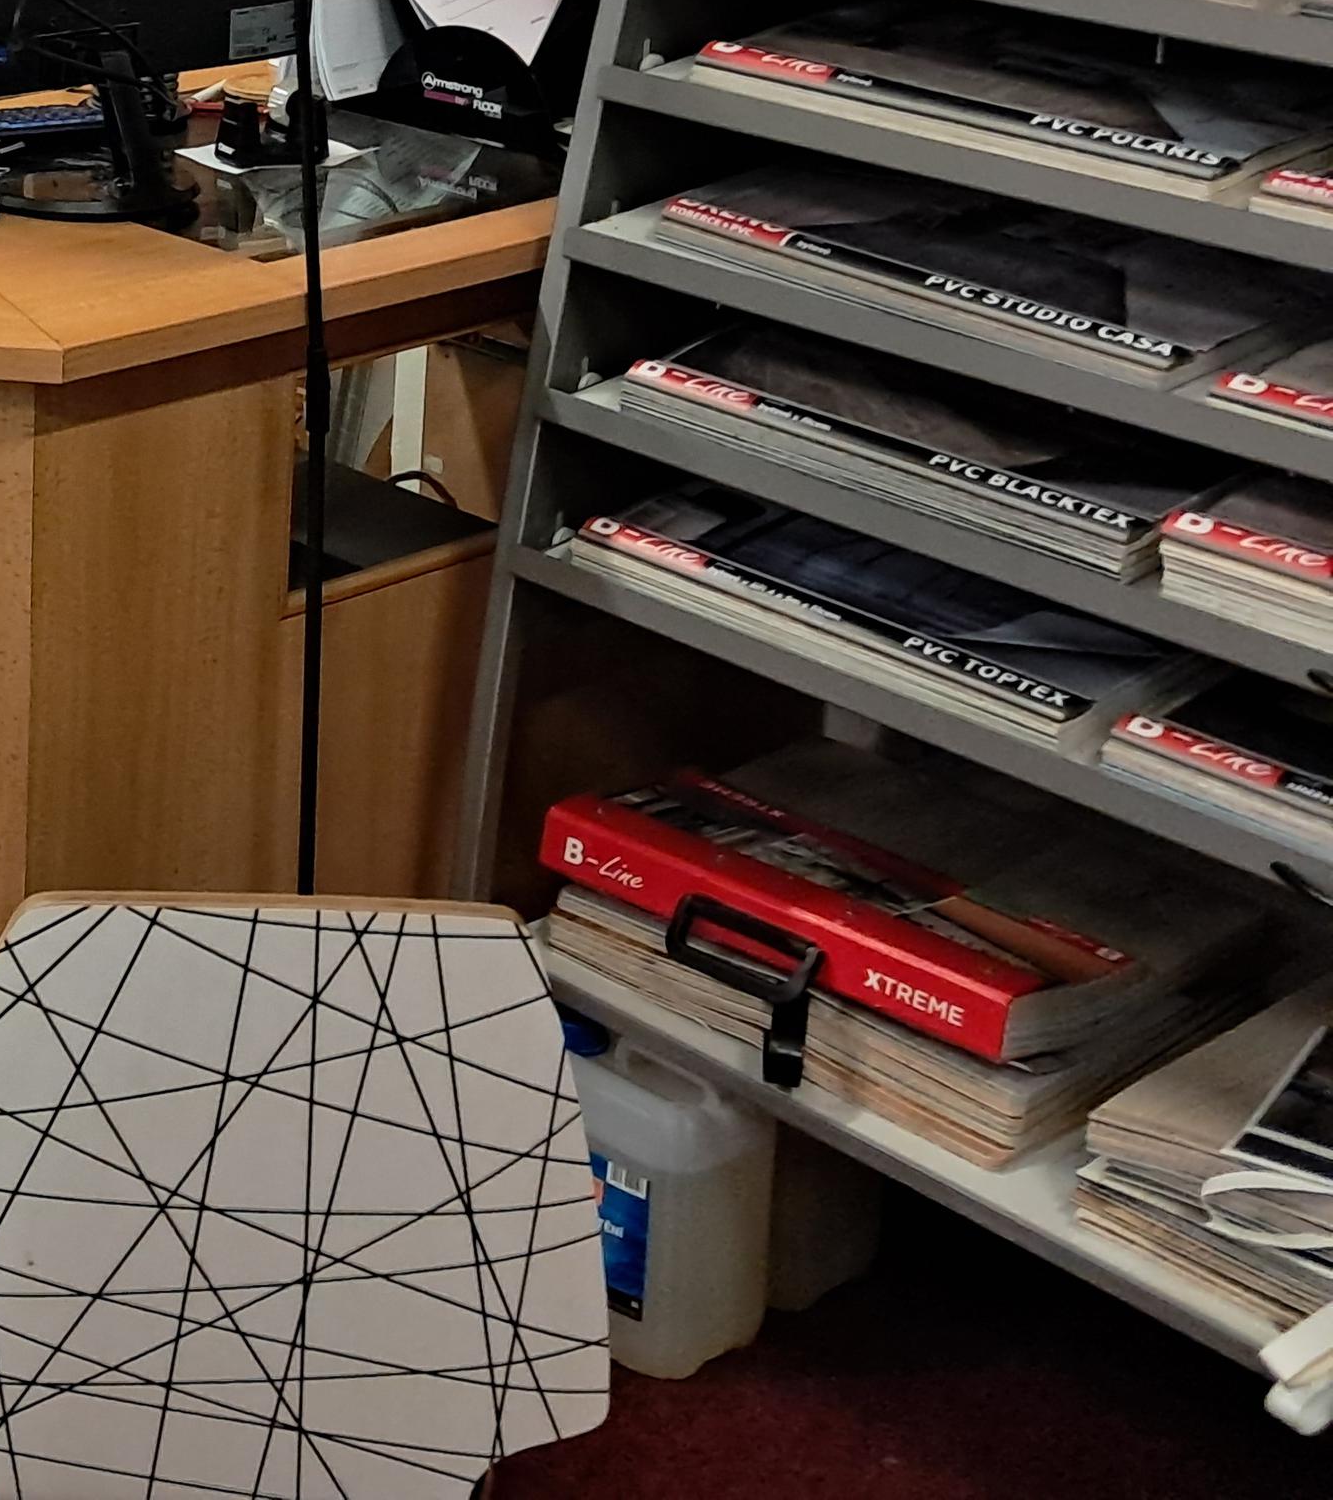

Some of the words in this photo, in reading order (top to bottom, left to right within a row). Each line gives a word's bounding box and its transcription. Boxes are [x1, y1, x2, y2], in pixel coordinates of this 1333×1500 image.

[421, 71, 483, 99] Armstrong
[1030, 113, 1089, 137] PVC
[1091, 125, 1223, 167] POLARIS
[924, 274, 979, 299] PVC
[981, 290, 1093, 332] STUDIO
[1096, 323, 1175, 358] CASA
[929, 452, 985, 482] PVC
[988, 473, 1137, 530] BLACKTEX
[902, 636, 961, 666] PVC
[963, 654, 1071, 708] TOPTEX
[563, 836, 645, 891] B-Line
[862, 967, 966, 1028] XTREME
